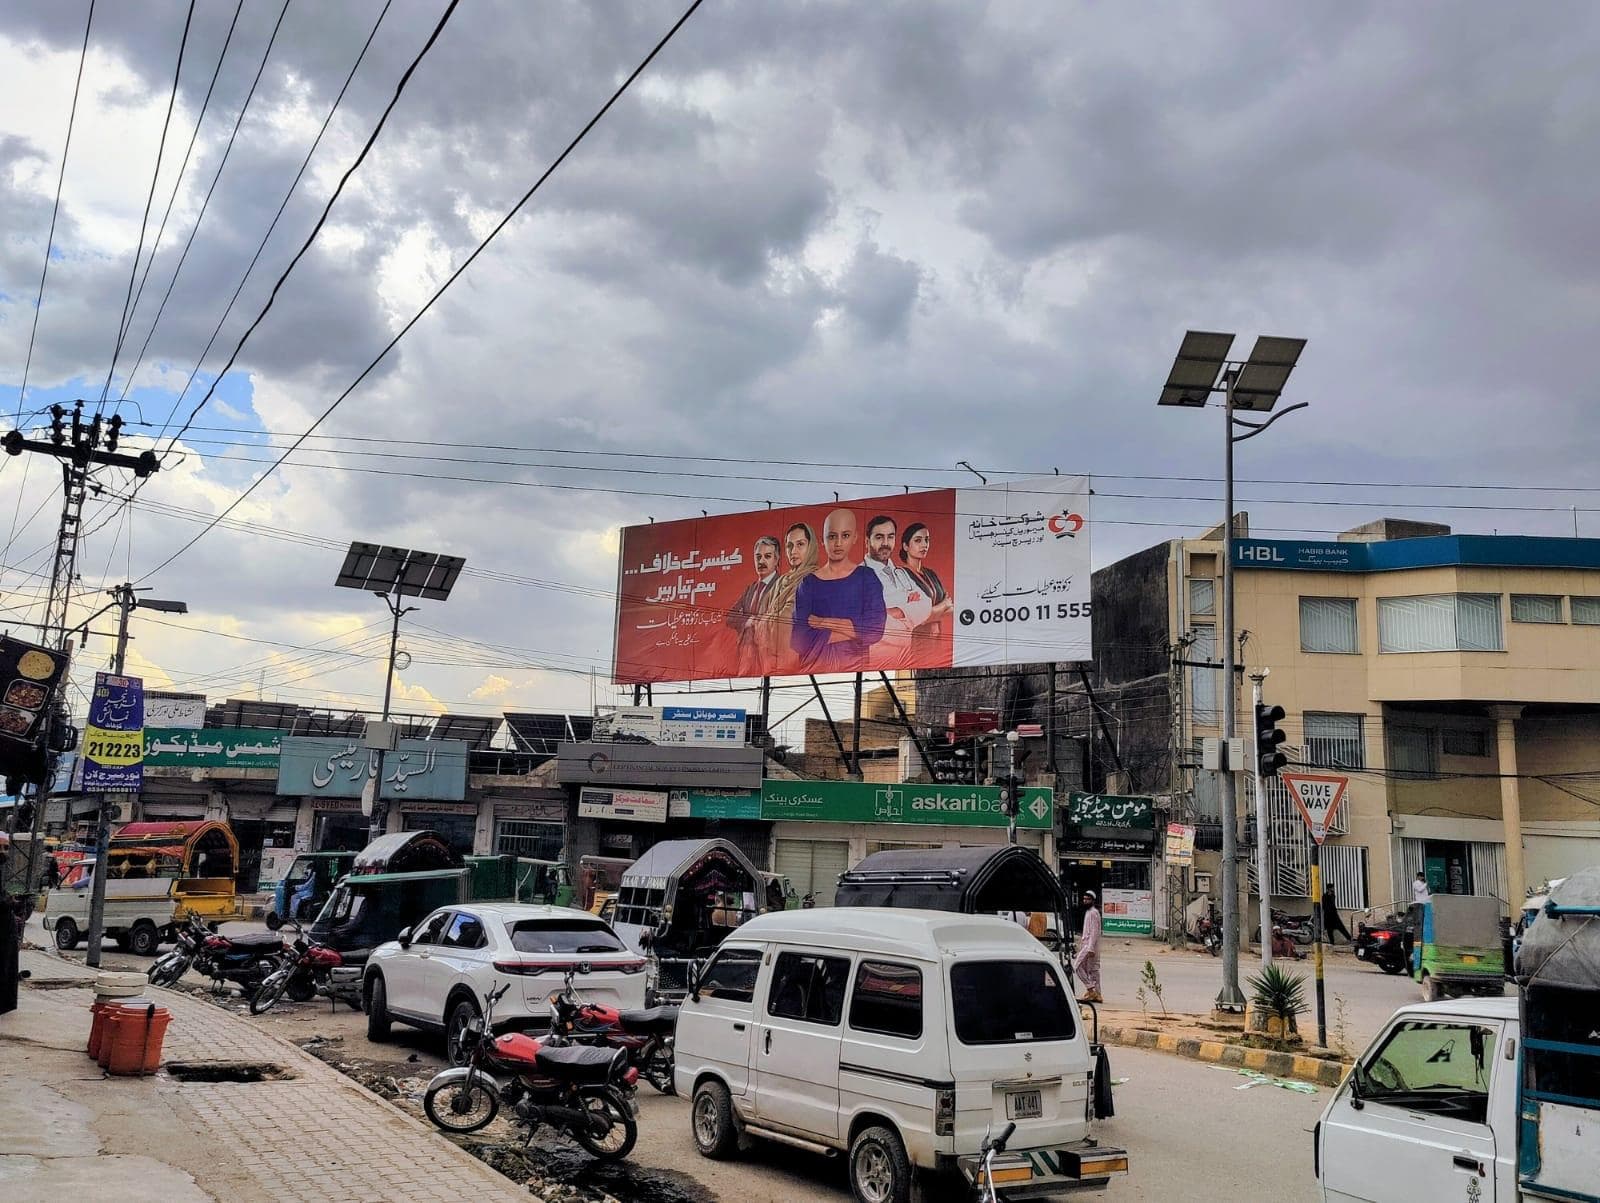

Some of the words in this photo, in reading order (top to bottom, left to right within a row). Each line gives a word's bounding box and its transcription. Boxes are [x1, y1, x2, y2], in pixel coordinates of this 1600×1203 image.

[968, 516, 998, 530] خانم
[1000, 511, 1044, 525] شوکت
[681, 550, 700, 569] کے
[700, 548, 742, 571] کینسر
[1239, 546, 1285, 561] HBL
[645, 585, 671, 603] ہیں
[669, 575, 694, 601] تیار
[691, 582, 715, 605] ہم
[980, 606, 1030, 624] 0800
[1036, 605, 1050, 620] 11
[1057, 602, 1092, 618] 555
[97, 706, 129, 723] نمائش
[692, 710, 717, 720] موبائل
[89, 742, 104, 757] 21
[105, 742, 122, 757] 22
[124, 744, 141, 758] 23
[226, 736, 280, 758] شمس
[1300, 784, 1331, 797] GIVE
[764, 793, 787, 806] بینک
[788, 793, 824, 806] عسکری
[1302, 797, 1331, 809] WAY
[1111, 800, 1147, 820] مومن
